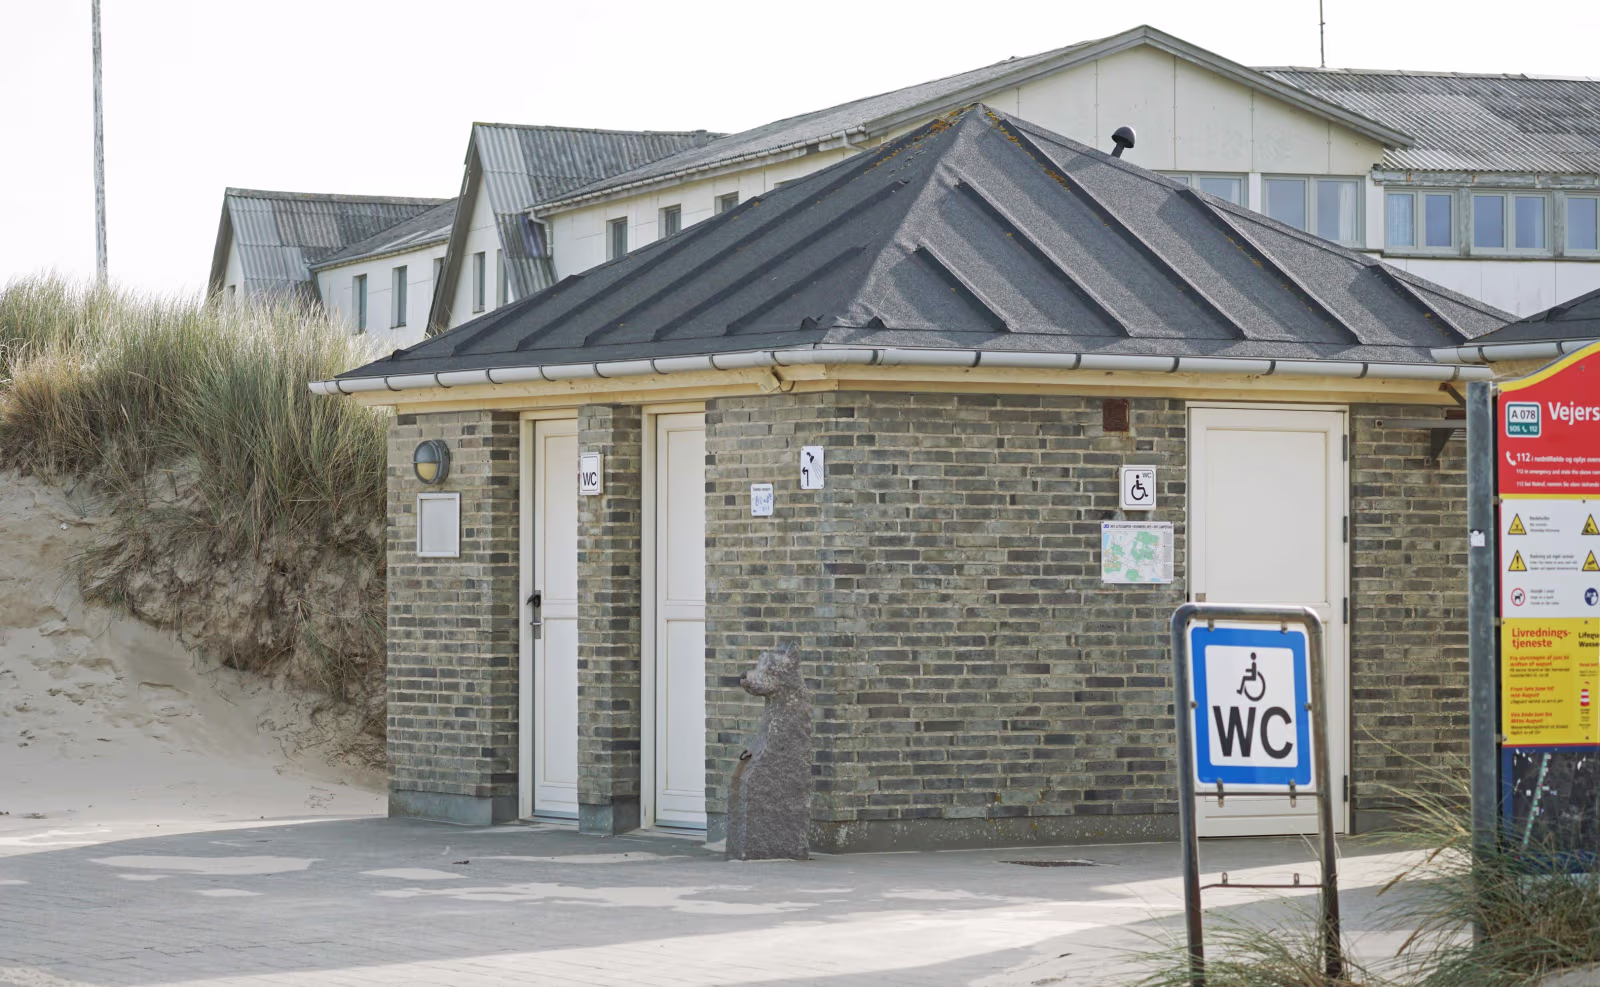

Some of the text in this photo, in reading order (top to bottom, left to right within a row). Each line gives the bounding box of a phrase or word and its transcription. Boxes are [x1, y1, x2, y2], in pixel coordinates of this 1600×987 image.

[1511, 409, 1536, 419] A 078
[1548, 401, 1600, 425] Vejers
[1516, 452, 1531, 462] 112
[582, 471, 597, 486] WC
[1512, 628, 1572, 640] Livrednings-
[1512, 638, 1553, 650] tjeneste
[1213, 706, 1293, 759] WC
